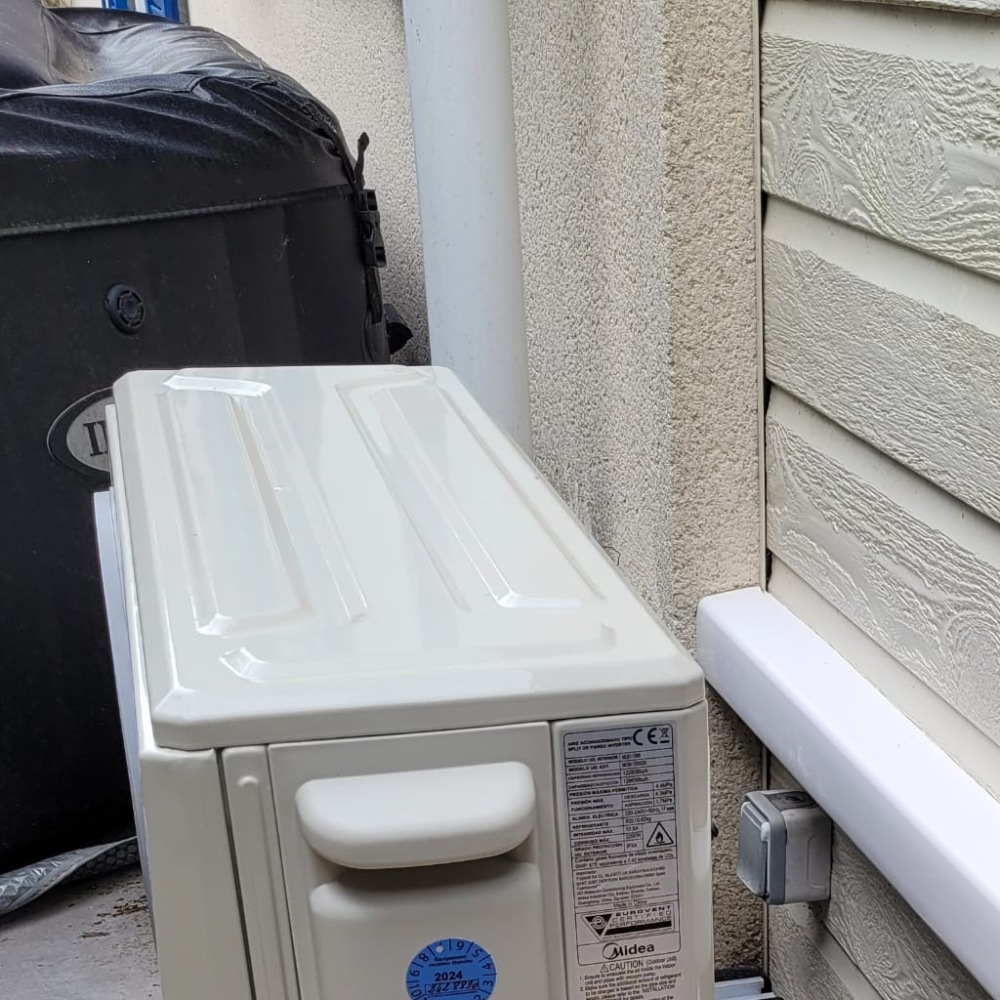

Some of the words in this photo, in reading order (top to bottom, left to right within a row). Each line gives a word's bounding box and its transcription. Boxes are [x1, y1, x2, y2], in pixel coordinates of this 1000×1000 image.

[612, 910, 671, 922] CERTIFIED
[615, 905, 671, 916] EUROVENT
[609, 915, 671, 928] PERFORMANCE
[605, 943, 654, 959] Midea
[609, 959, 643, 971] CAUTION
[434, 971, 462, 982] 2024
[642, 984, 675, 992] INSTALLATION
